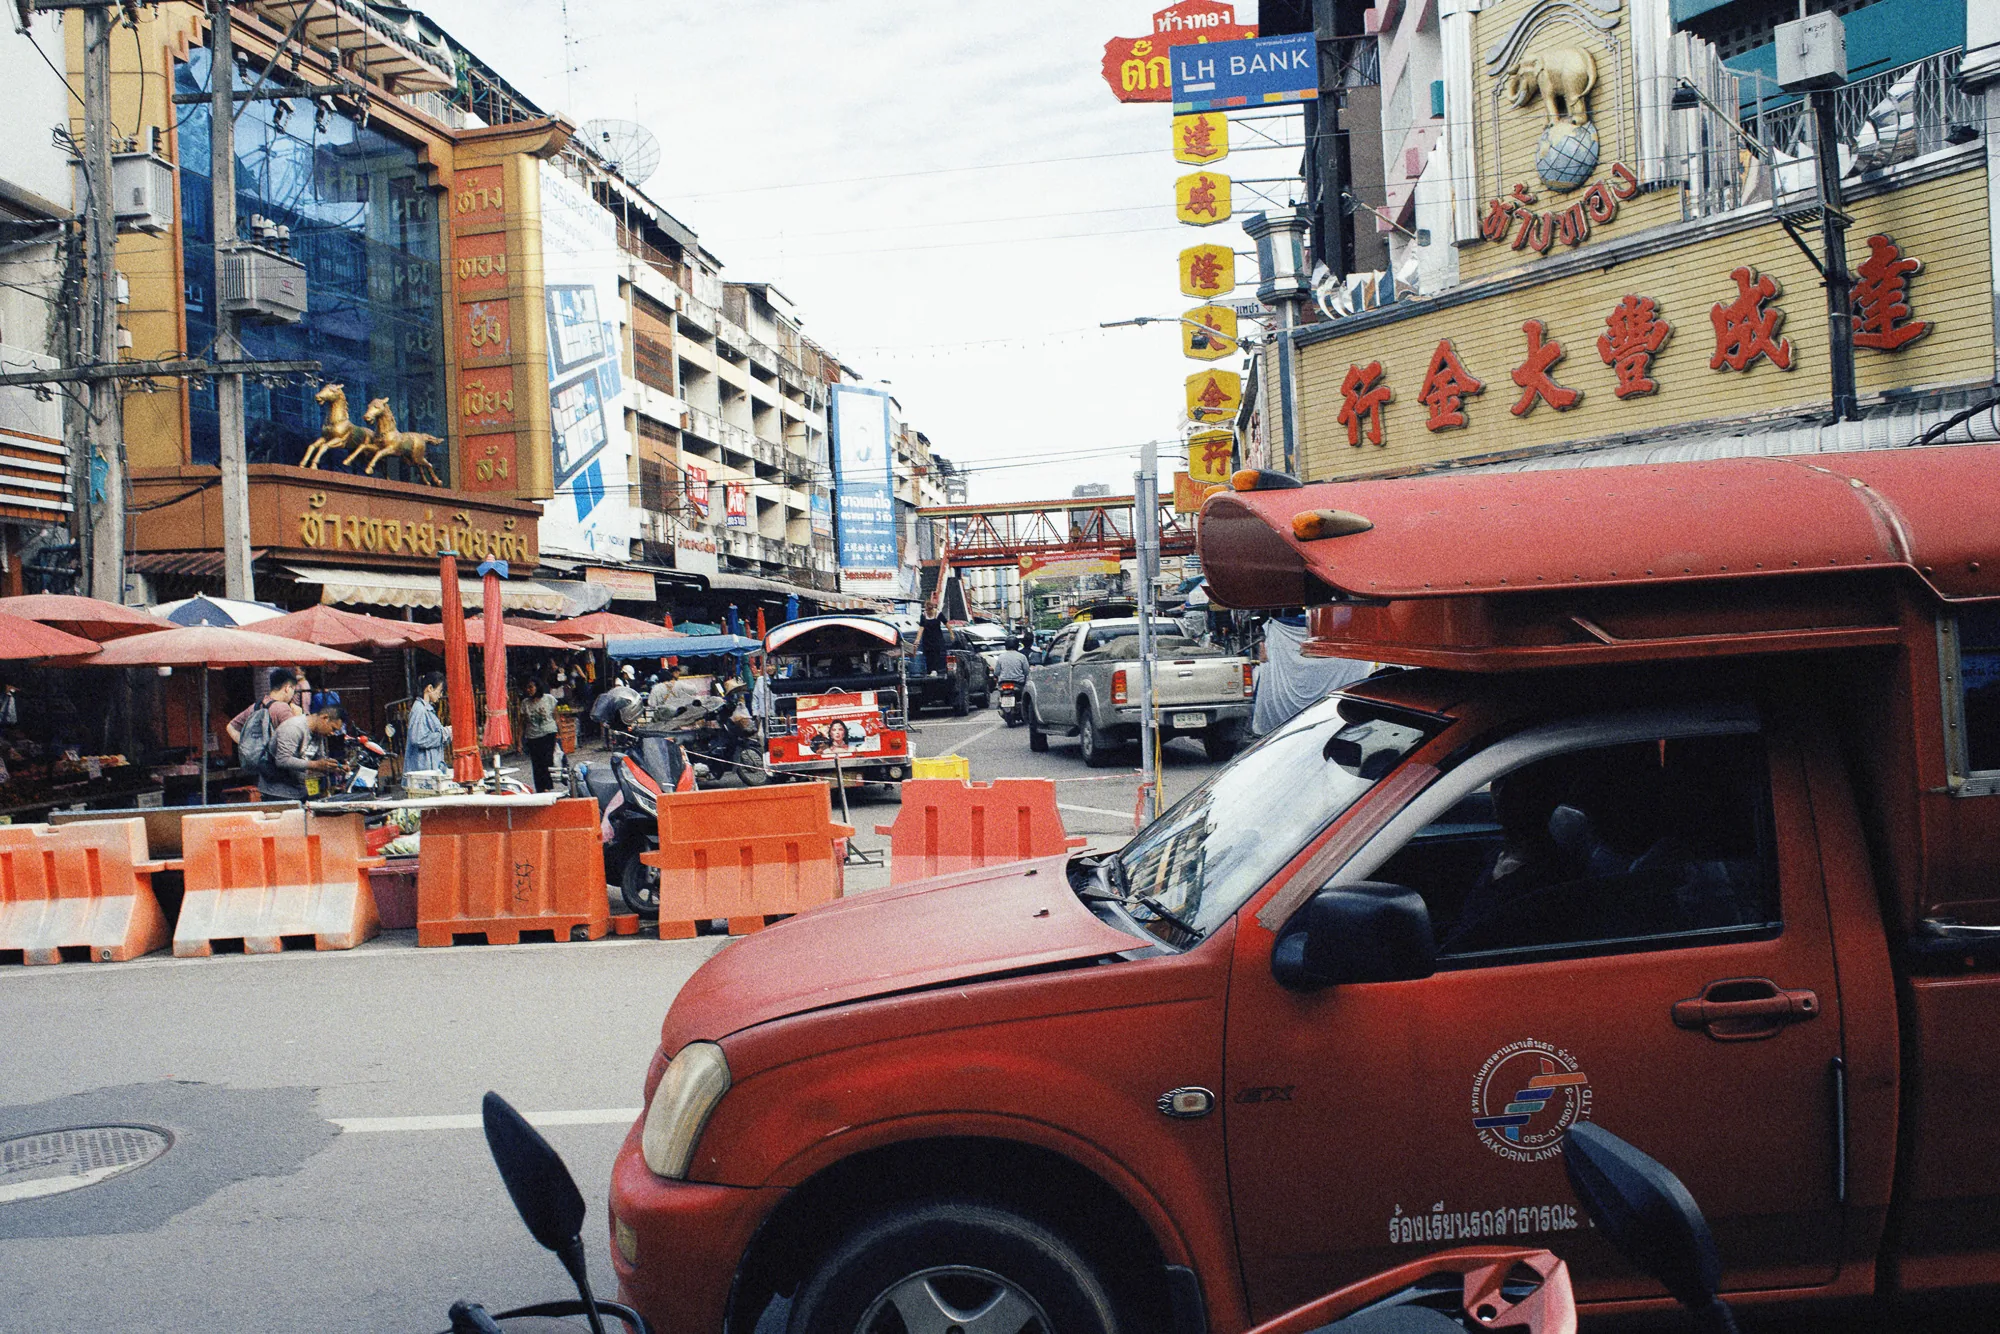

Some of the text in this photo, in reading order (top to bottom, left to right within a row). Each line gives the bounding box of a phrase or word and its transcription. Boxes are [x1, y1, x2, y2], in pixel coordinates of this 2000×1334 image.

[1157, 10, 1231, 33] ห้างทอง
[1181, 48, 1310, 81] LH BANK
[456, 178, 503, 214] ห้าง
[1482, 161, 1638, 254] ห้างทอง
[458, 253, 507, 280] ทอง
[1557, 1047, 1580, 1071] จำกัด
[1522, 1086, 1574, 1145] 053-016502-3
[1477, 1128, 1565, 1163] NAKORNLANN
[1388, 1199, 1579, 1244] ร้องเรียนรถสาธารณะ
